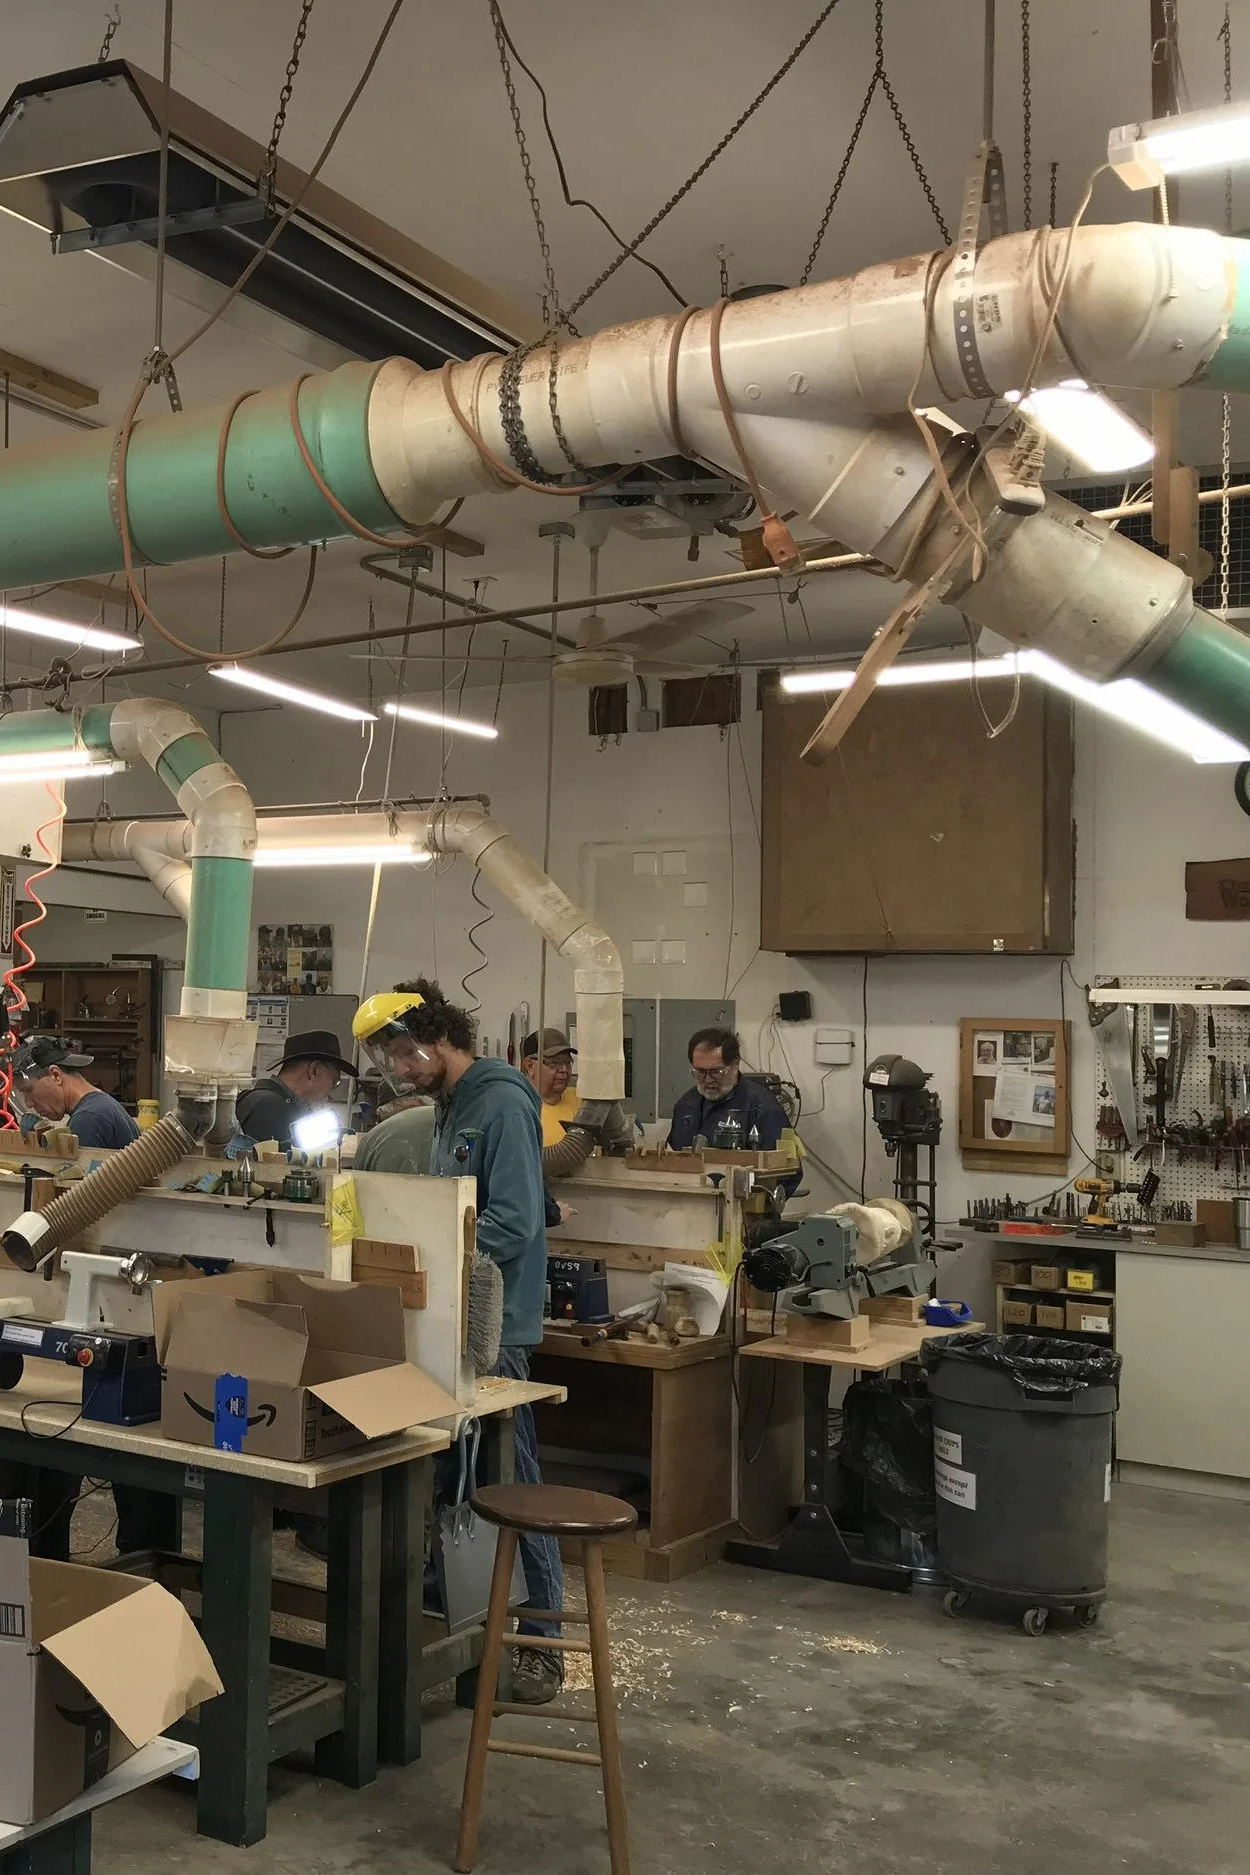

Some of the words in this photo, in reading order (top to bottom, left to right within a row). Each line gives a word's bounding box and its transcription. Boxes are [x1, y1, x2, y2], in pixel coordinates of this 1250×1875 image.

[486, 381, 499, 393] PV
[518, 371, 546, 386] EWER
[949, 1477, 968, 1490] except
[954, 1488, 966, 1499] can
